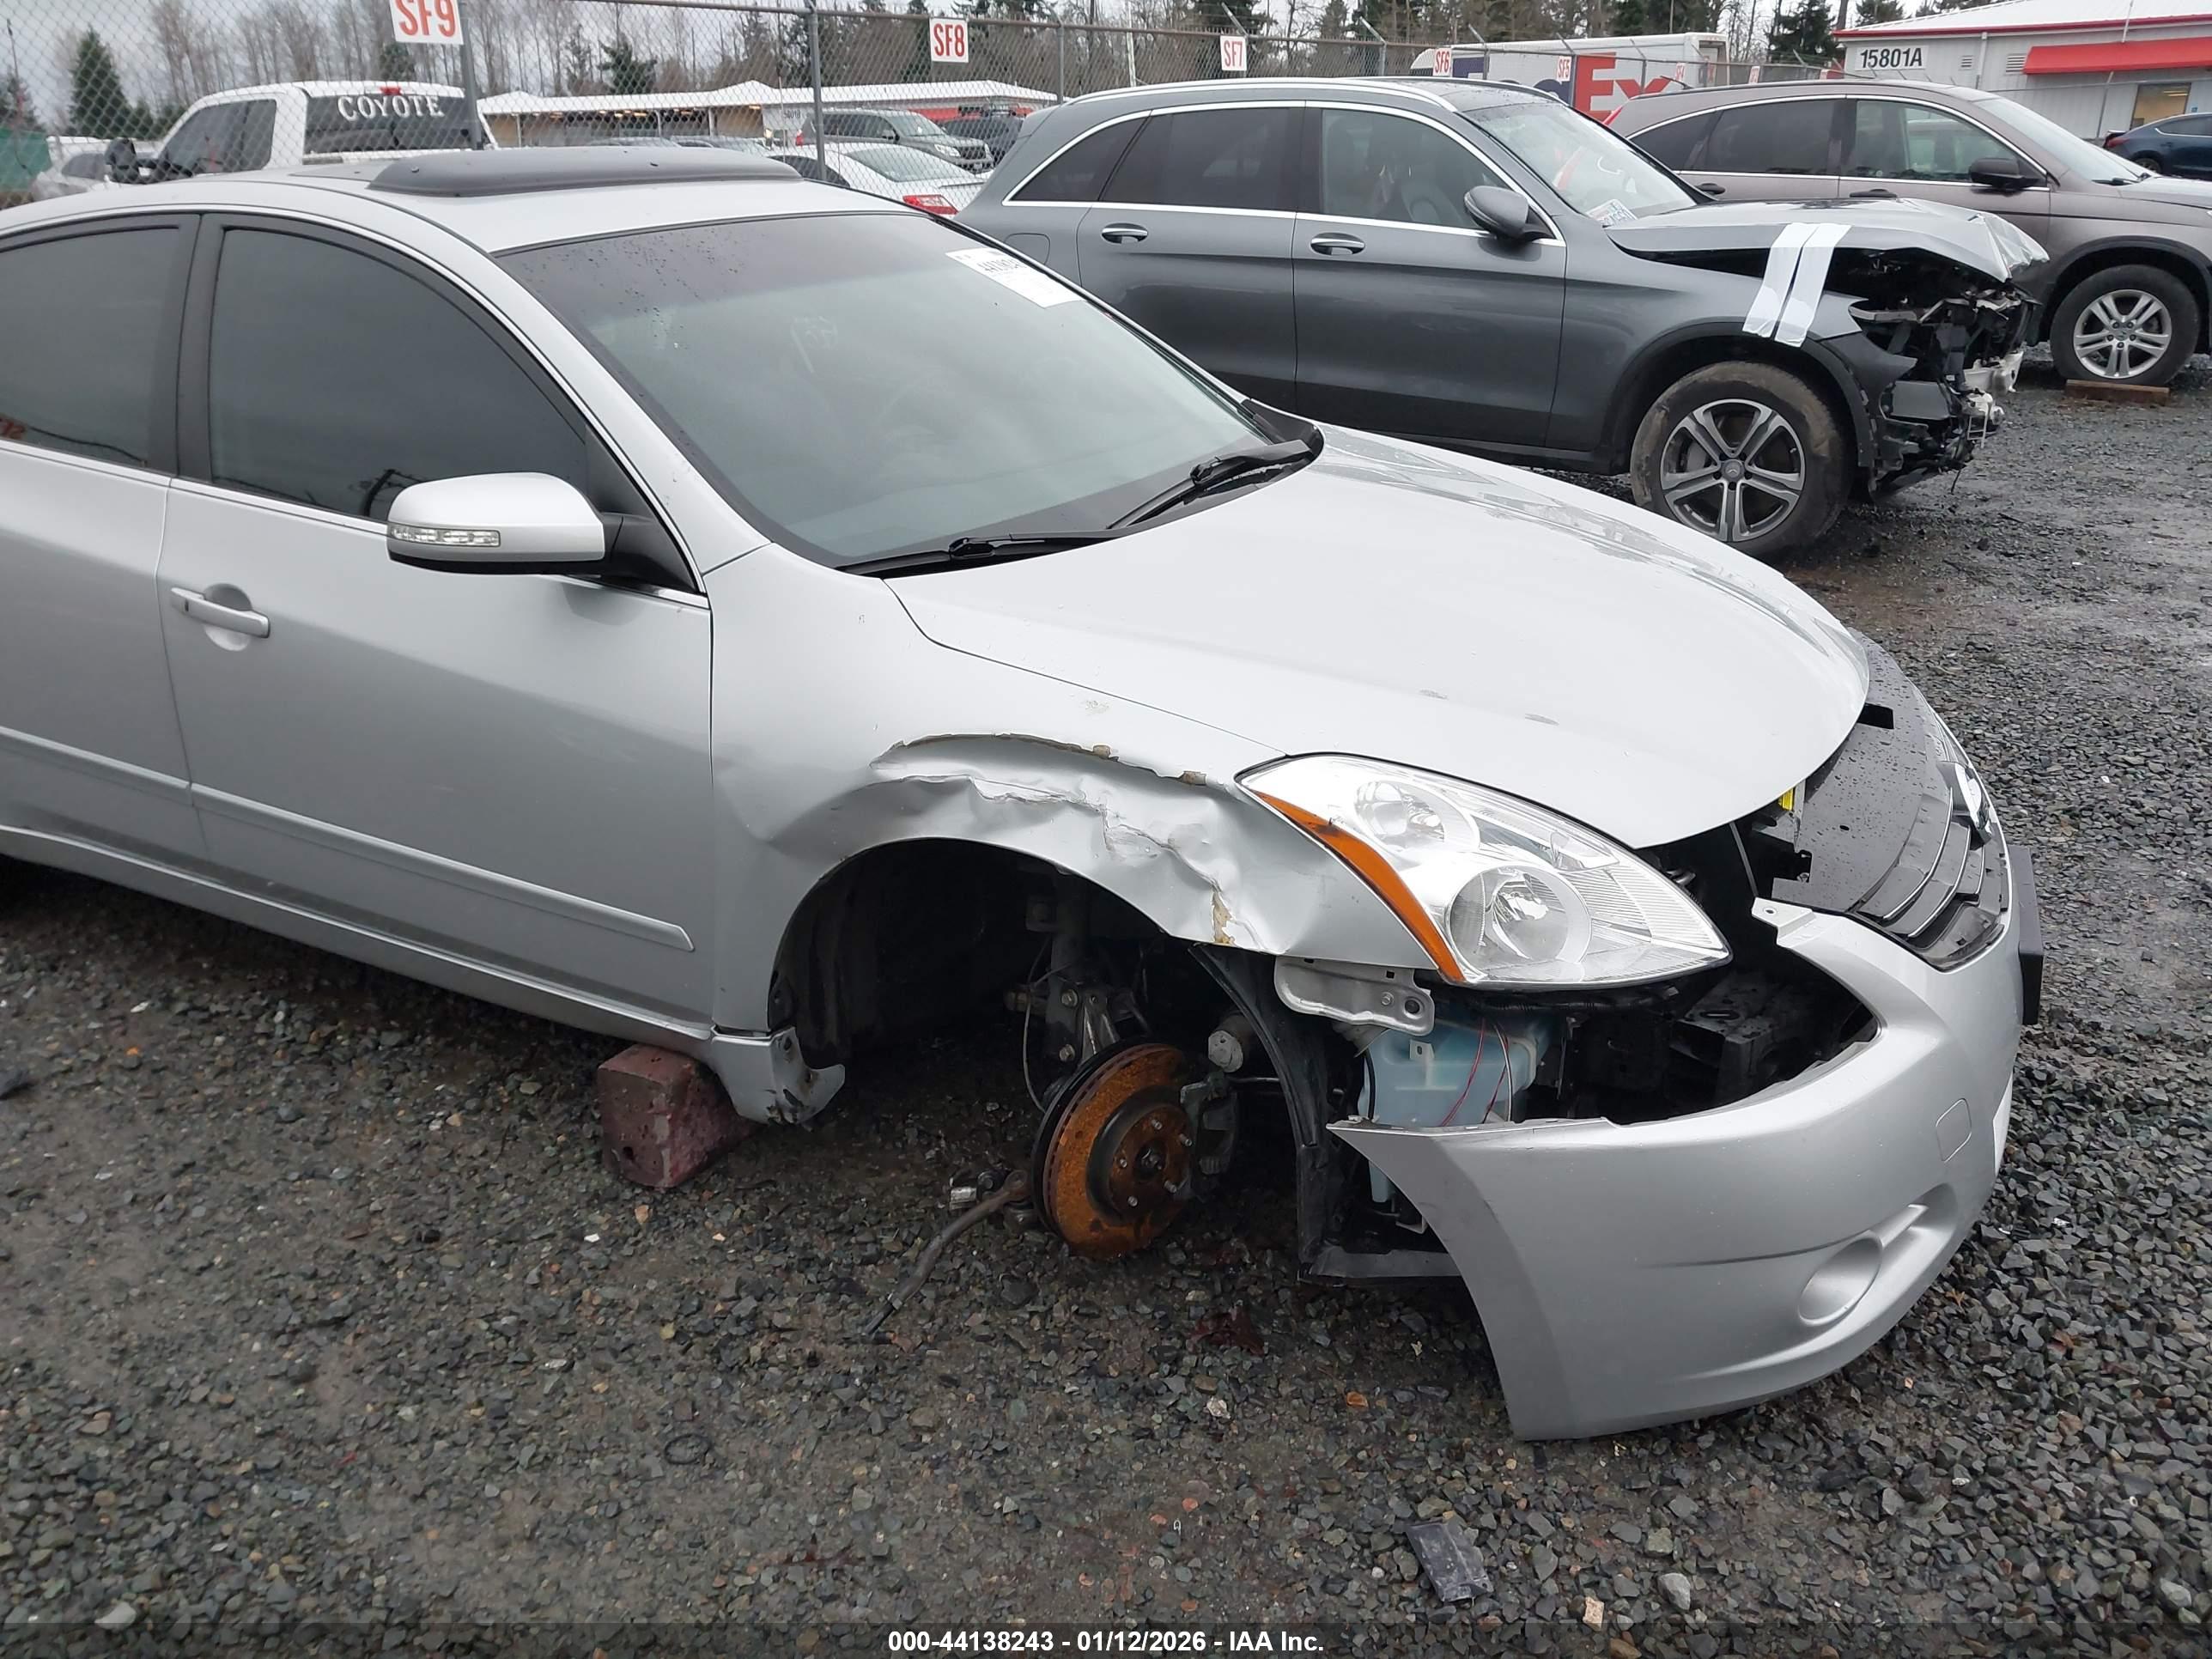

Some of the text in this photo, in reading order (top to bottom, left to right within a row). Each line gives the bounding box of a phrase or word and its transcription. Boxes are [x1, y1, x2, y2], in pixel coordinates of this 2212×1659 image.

[394, 0, 456, 37] SF9
[933, 22, 965, 58] SF8
[1224, 40, 1243, 67] SF7
[1435, 51, 1449, 74] SF6
[1558, 58, 1570, 78] SF5
[1859, 47, 1923, 70] 15801A
[337, 94, 446, 122] COYOTE
